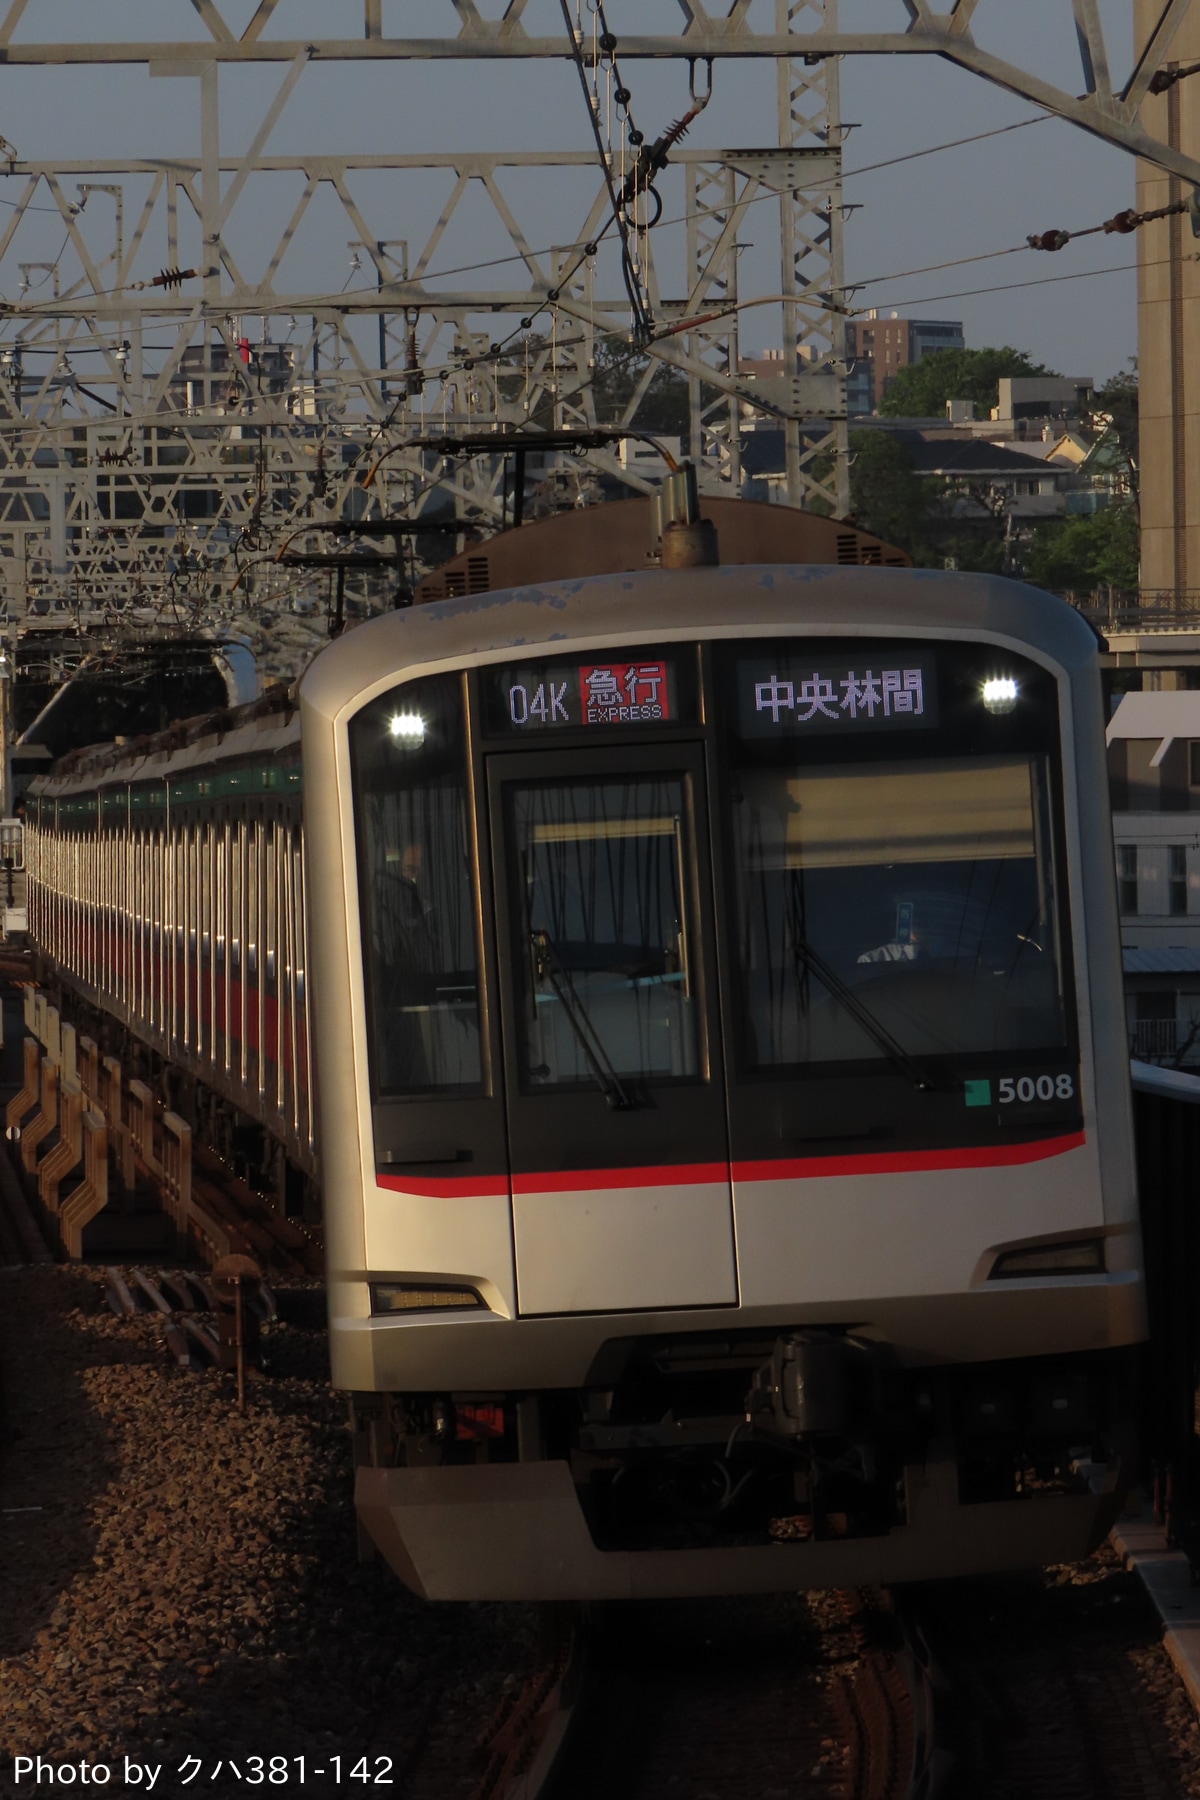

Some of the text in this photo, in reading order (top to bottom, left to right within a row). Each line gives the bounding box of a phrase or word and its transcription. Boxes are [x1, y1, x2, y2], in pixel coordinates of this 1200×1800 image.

[509, 681, 569, 724] 04K
[584, 666, 662, 706] 急行
[754, 669, 924, 723] 中央林間
[587, 705, 662, 723] EXPRESS
[998, 1073, 1074, 1104] 5008
